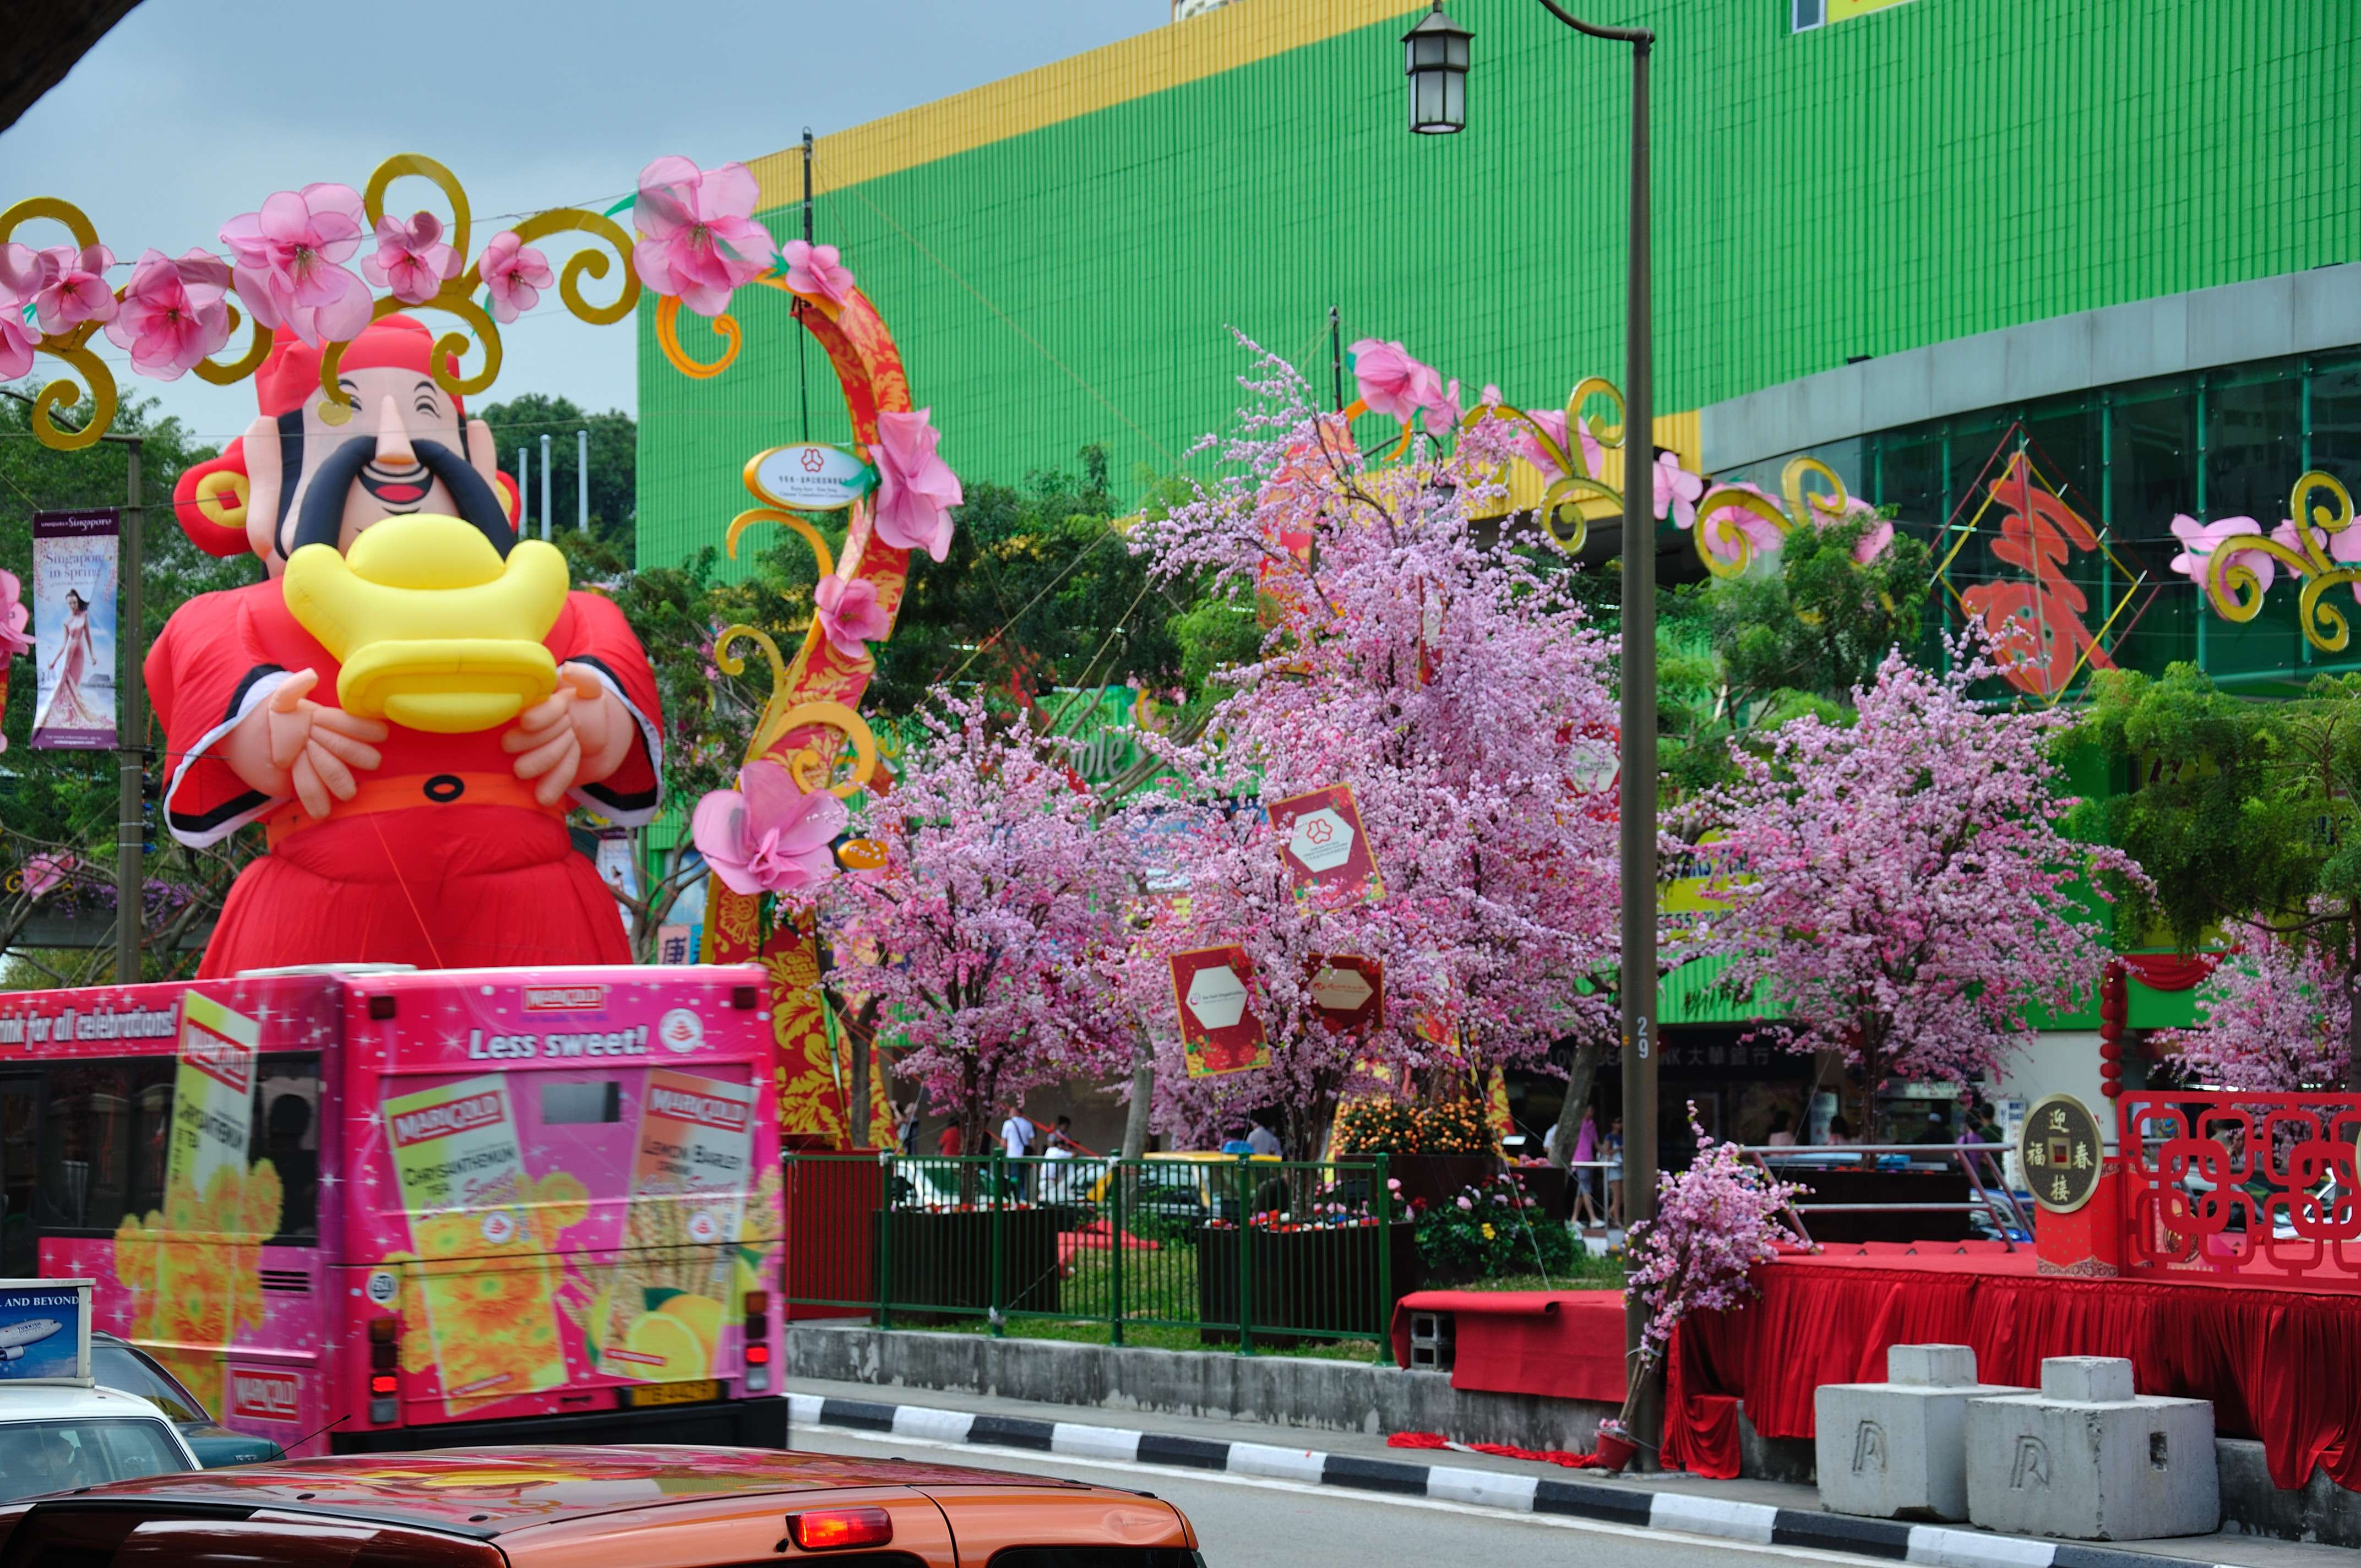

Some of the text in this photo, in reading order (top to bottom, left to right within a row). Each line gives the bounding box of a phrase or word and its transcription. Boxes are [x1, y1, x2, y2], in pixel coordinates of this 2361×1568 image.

[68, 516, 112, 532] Singapore
[50, 568, 61, 578] in
[25, 1010, 52, 1051] for
[53, 1008, 75, 1042] all
[76, 1002, 178, 1041] celebrations!
[469, 1024, 649, 1060] Less sweet!
[395, 1096, 502, 1143] MARIGOLD
[651, 1087, 746, 1128] MARIGOLD
[2026, 1108, 2094, 1202] 迎 春 接 福
[4, 1298, 30, 1307] AND
[34, 1295, 79, 1306] BEYOND
[233, 1377, 297, 1413] MARIGOLD
